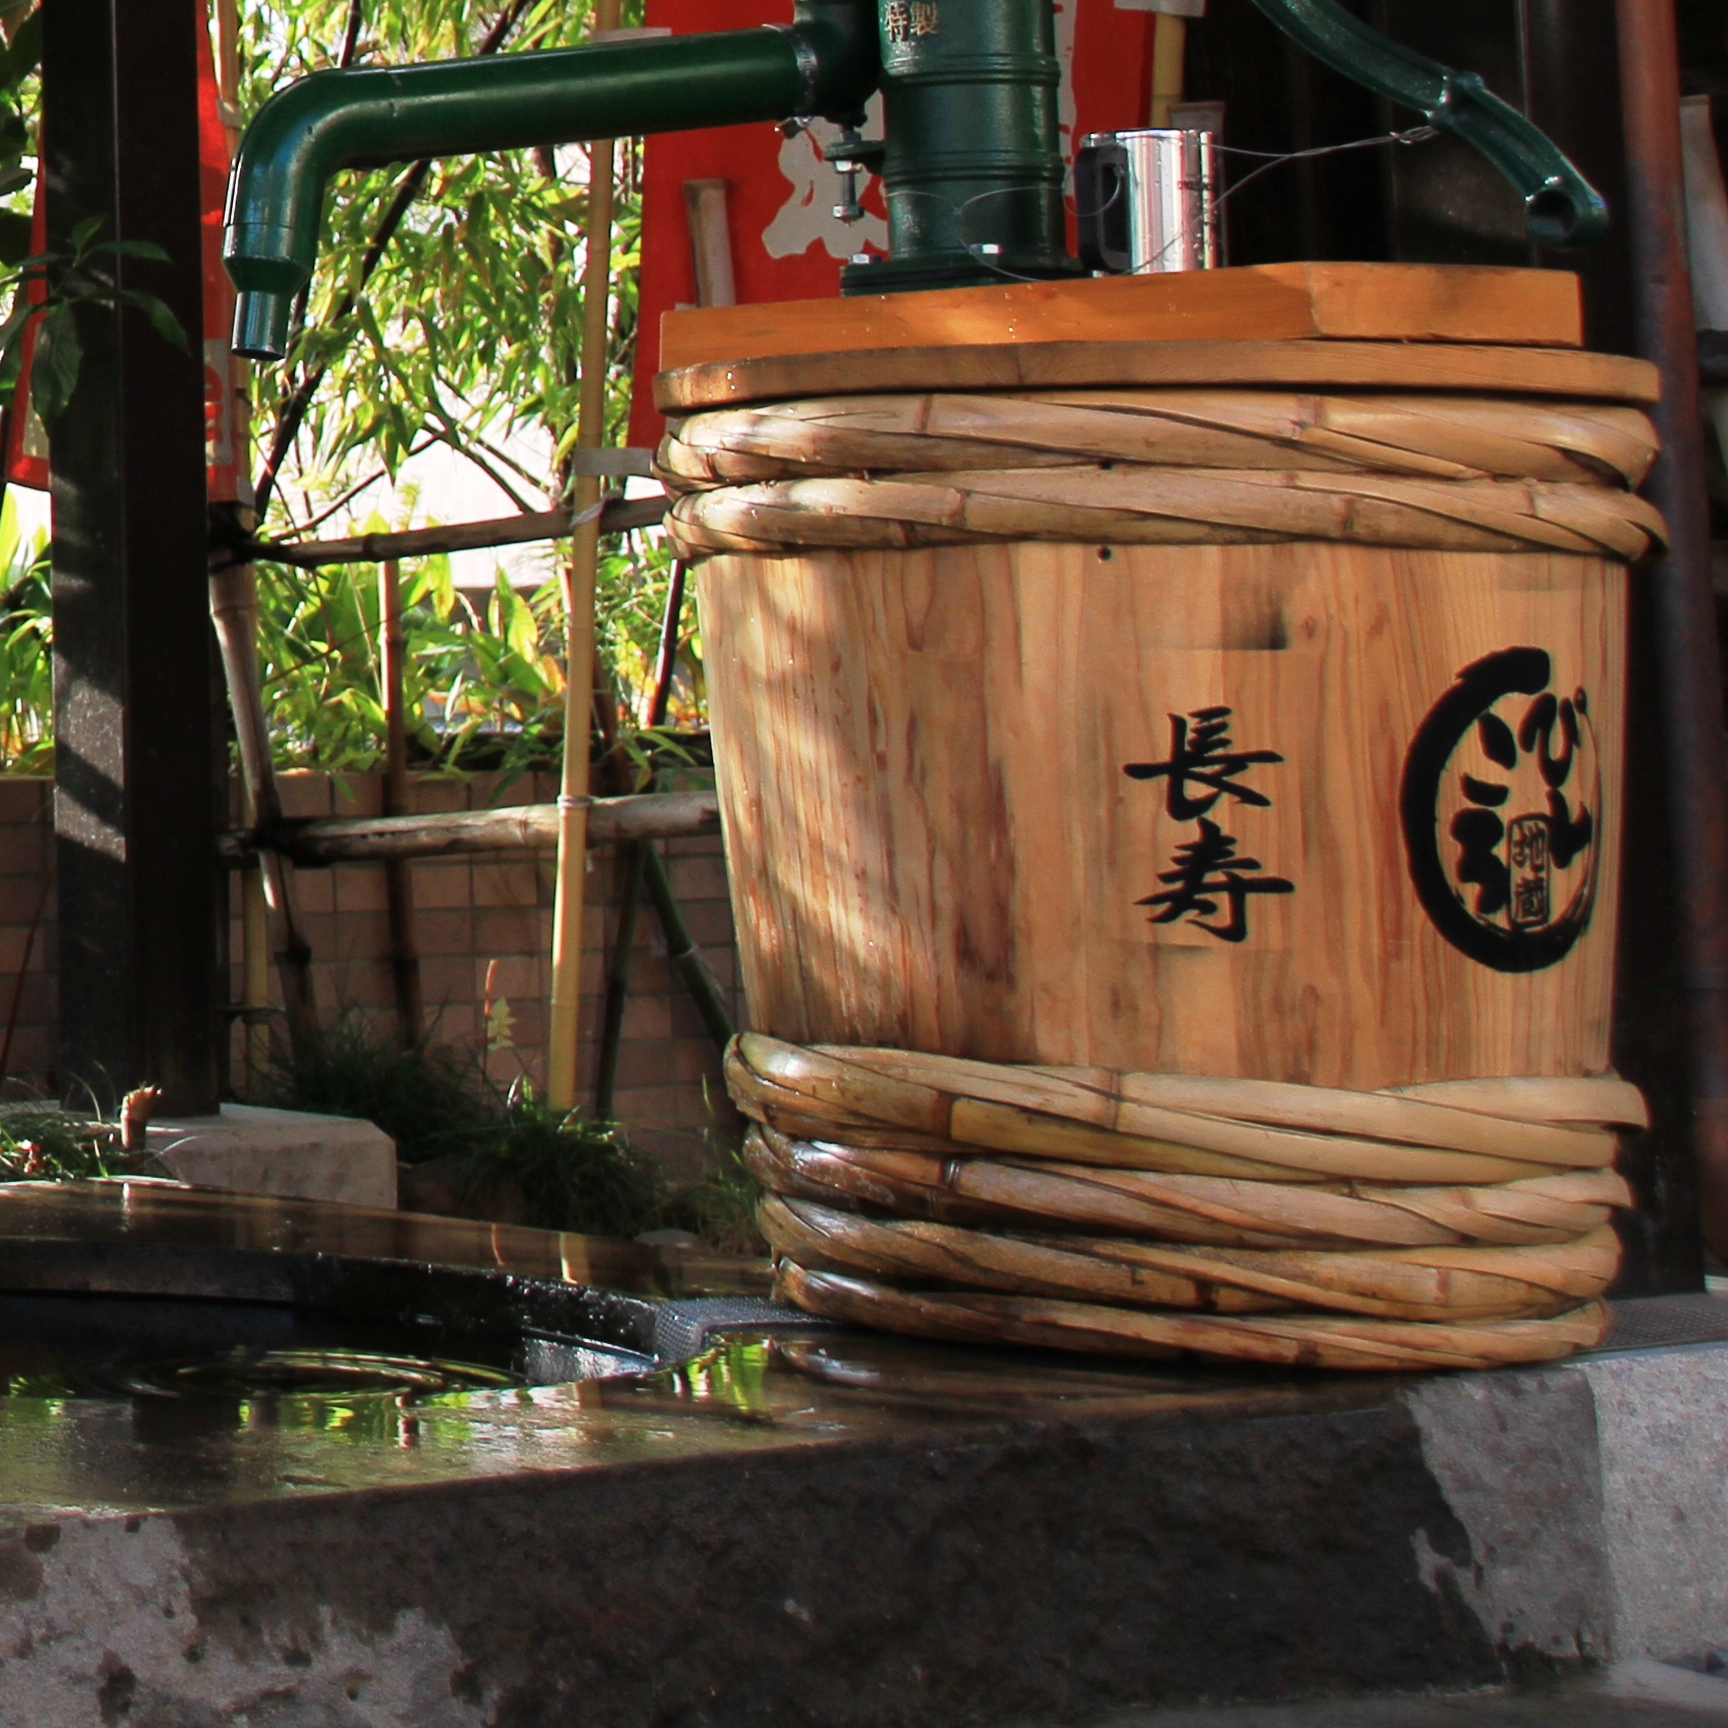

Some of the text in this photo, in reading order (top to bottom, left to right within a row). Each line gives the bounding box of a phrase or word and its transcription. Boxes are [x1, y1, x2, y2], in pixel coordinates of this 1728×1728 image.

[884, 0, 940, 42] 特製
[1124, 706, 1295, 943] 長寿
[1510, 821, 1549, 920] 地蔵
